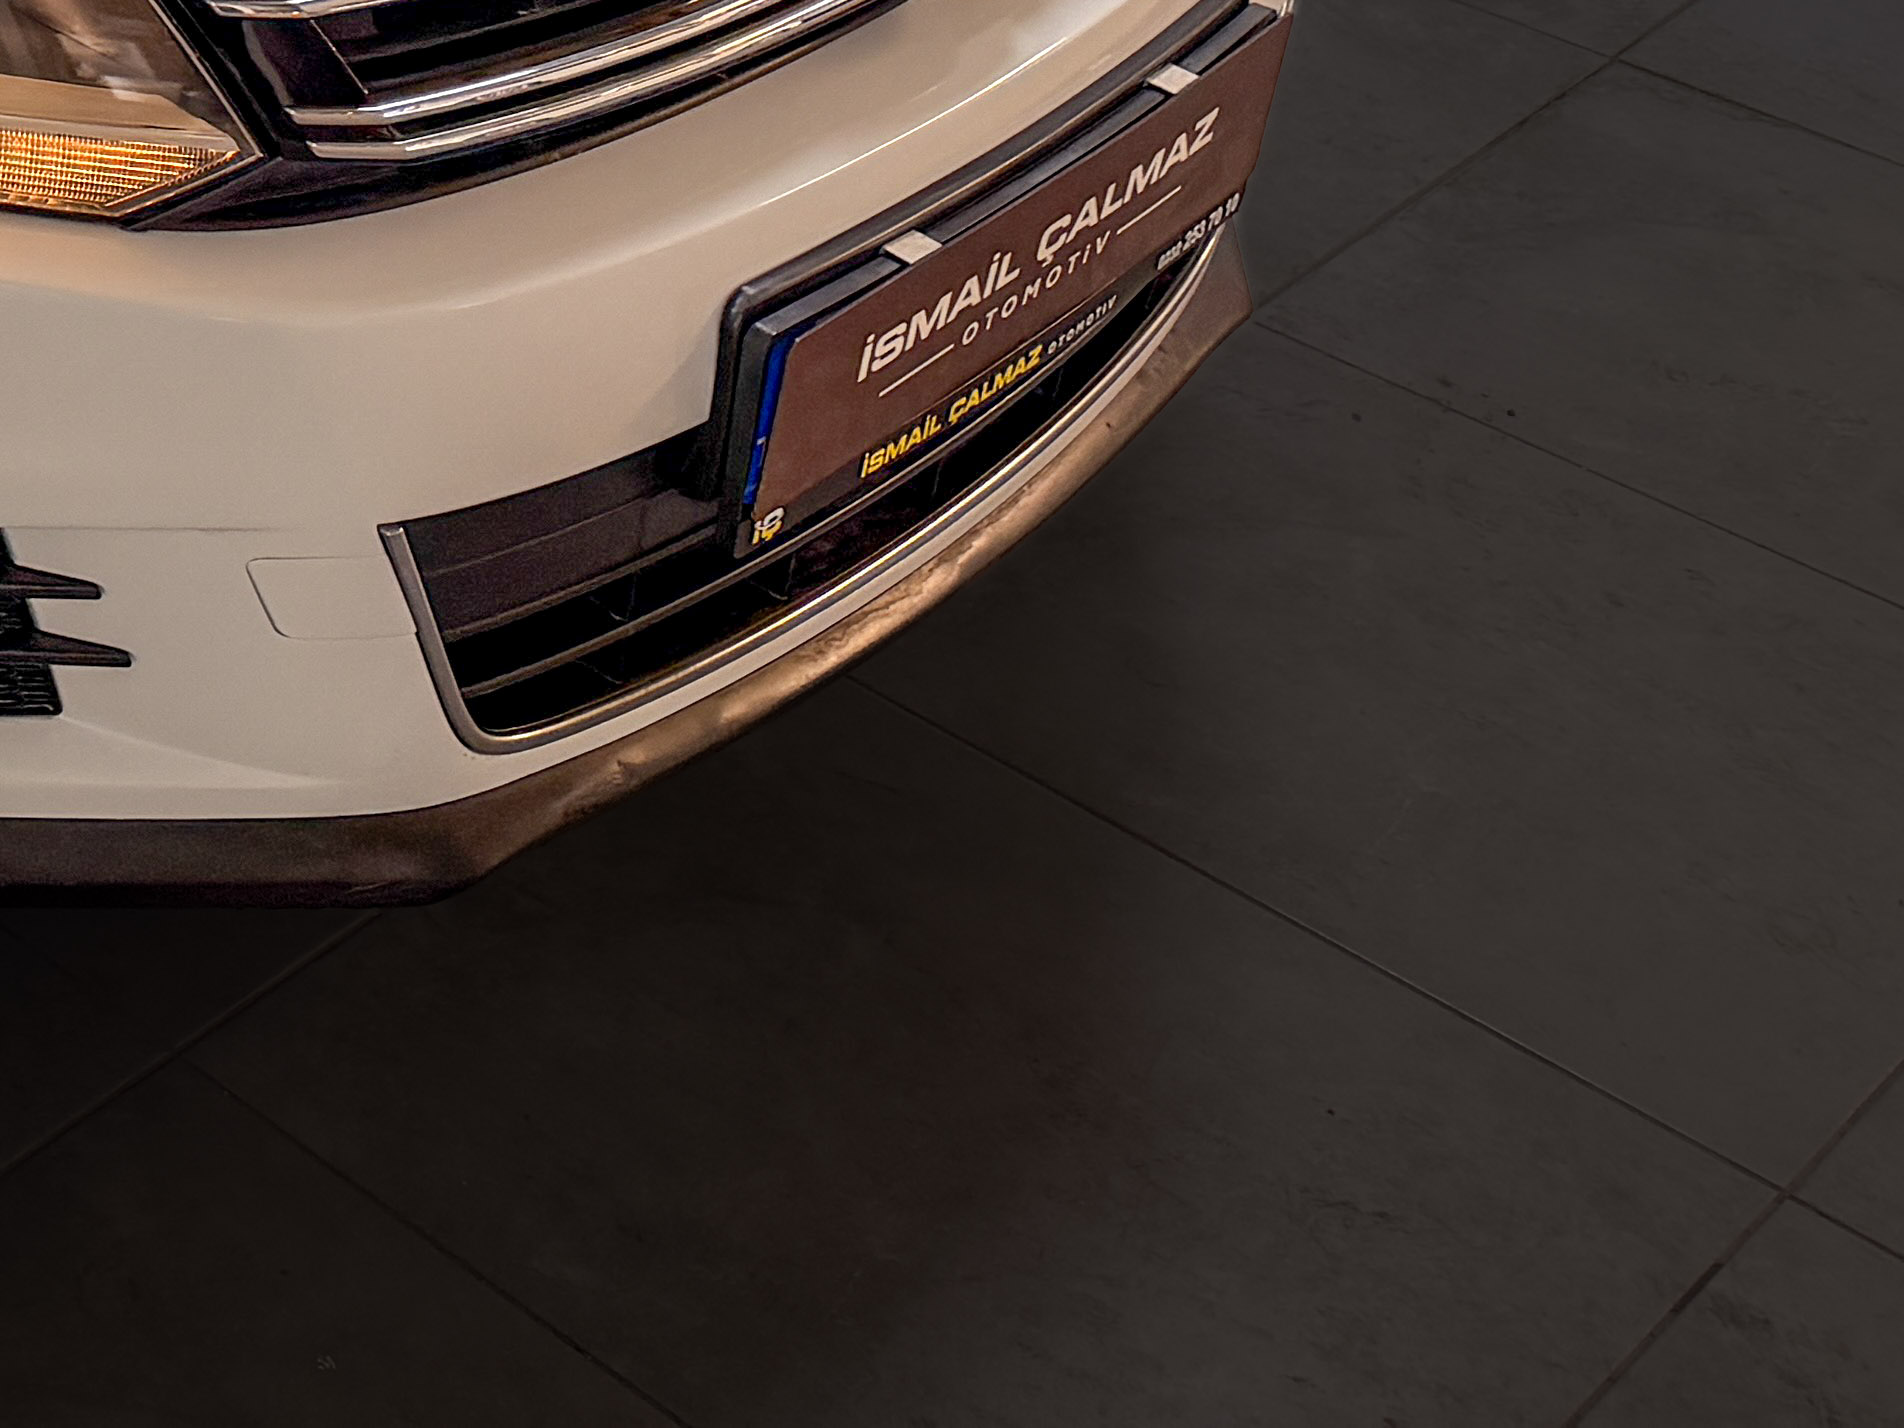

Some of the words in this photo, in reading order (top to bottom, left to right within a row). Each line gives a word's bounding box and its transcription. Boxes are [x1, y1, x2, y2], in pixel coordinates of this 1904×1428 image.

[857, 251, 1021, 383] İSMAİL
[1036, 107, 1221, 268] ÇALMAZ
[949, 344, 1043, 427] ÇALMAZ
